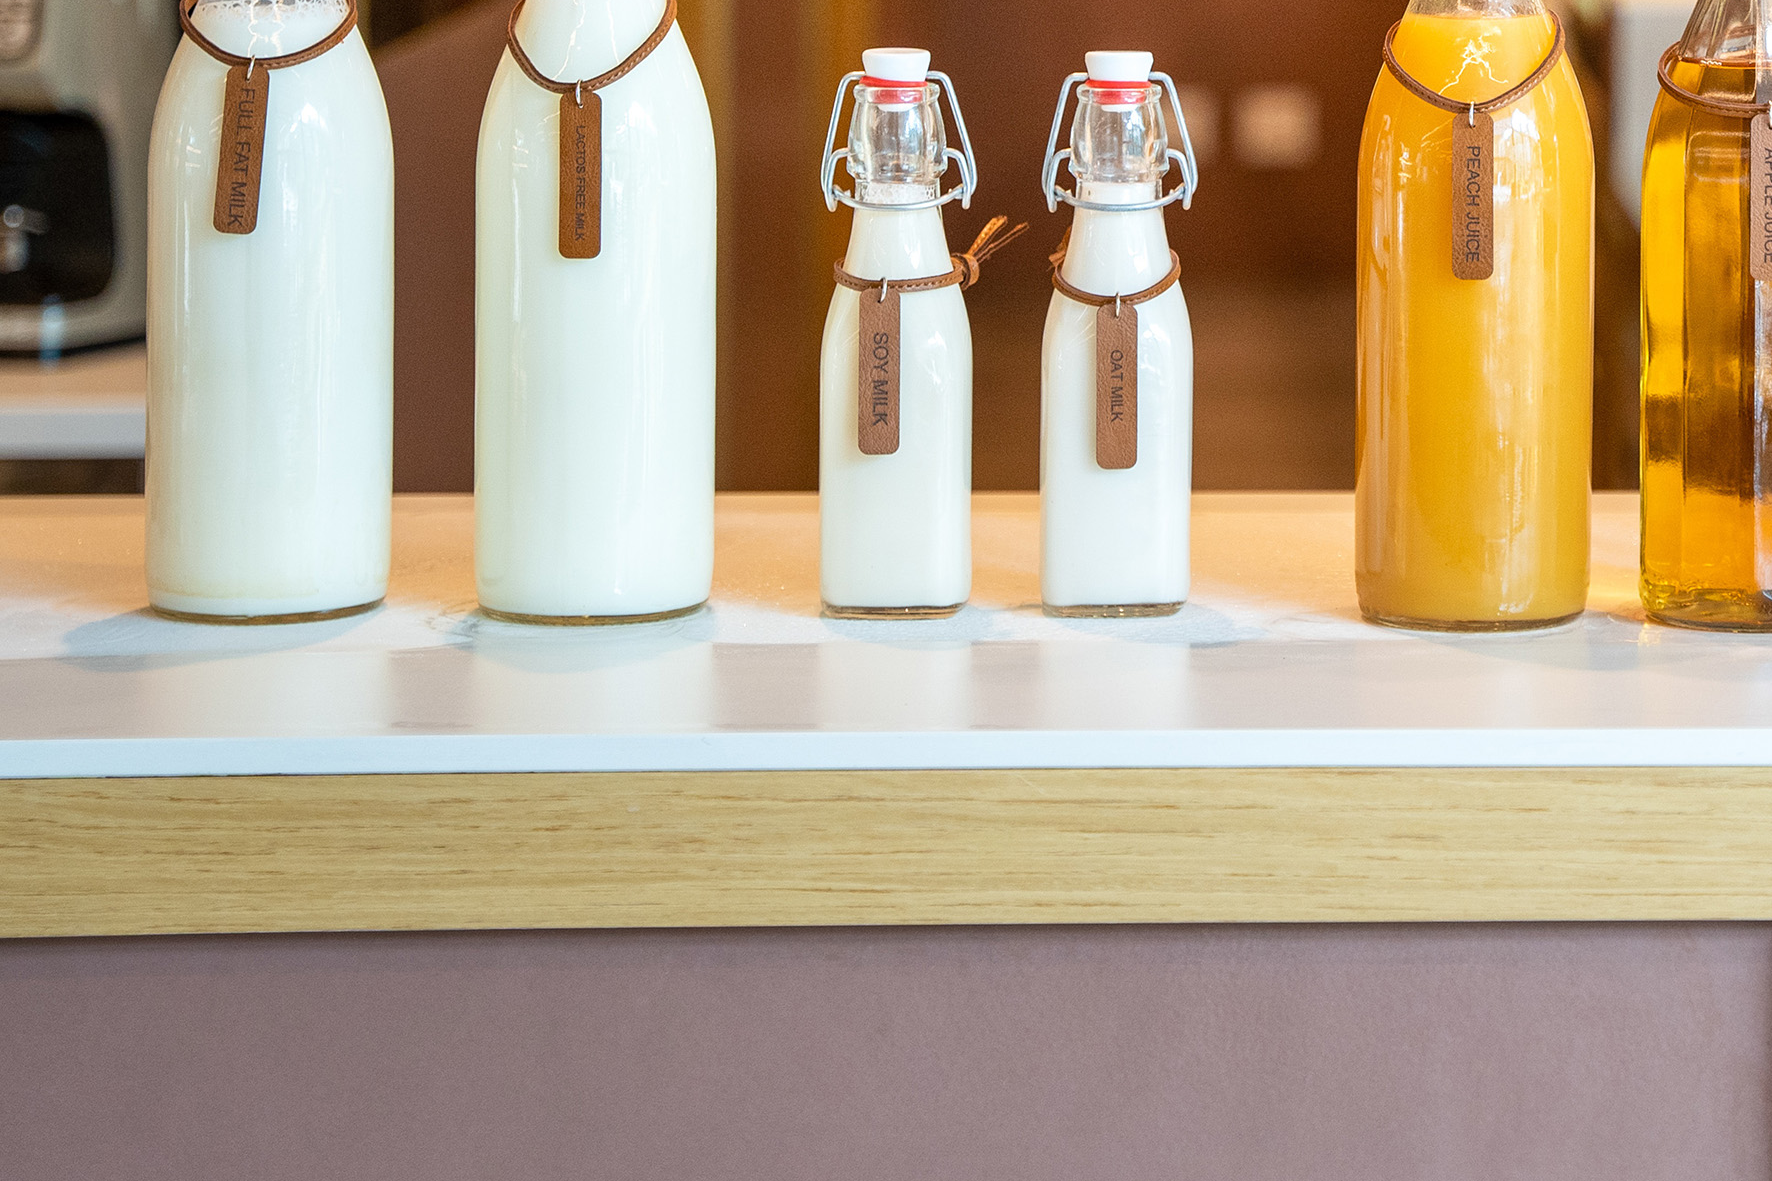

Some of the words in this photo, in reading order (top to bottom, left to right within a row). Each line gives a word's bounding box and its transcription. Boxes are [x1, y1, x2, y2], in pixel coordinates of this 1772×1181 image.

[236, 87, 256, 137] FULL
[233, 141, 252, 177] FAT
[575, 125, 587, 175] LACTOS
[575, 177, 586, 210] FREE
[1465, 145, 1481, 207] PEACH
[226, 181, 248, 228] MILK
[574, 211, 586, 242] MILK
[1465, 211, 1480, 263] JUICE
[873, 331, 889, 375] SOY
[1110, 349, 1124, 382] OAT
[872, 379, 889, 427] MILK
[1110, 385, 1124, 423] MILK
